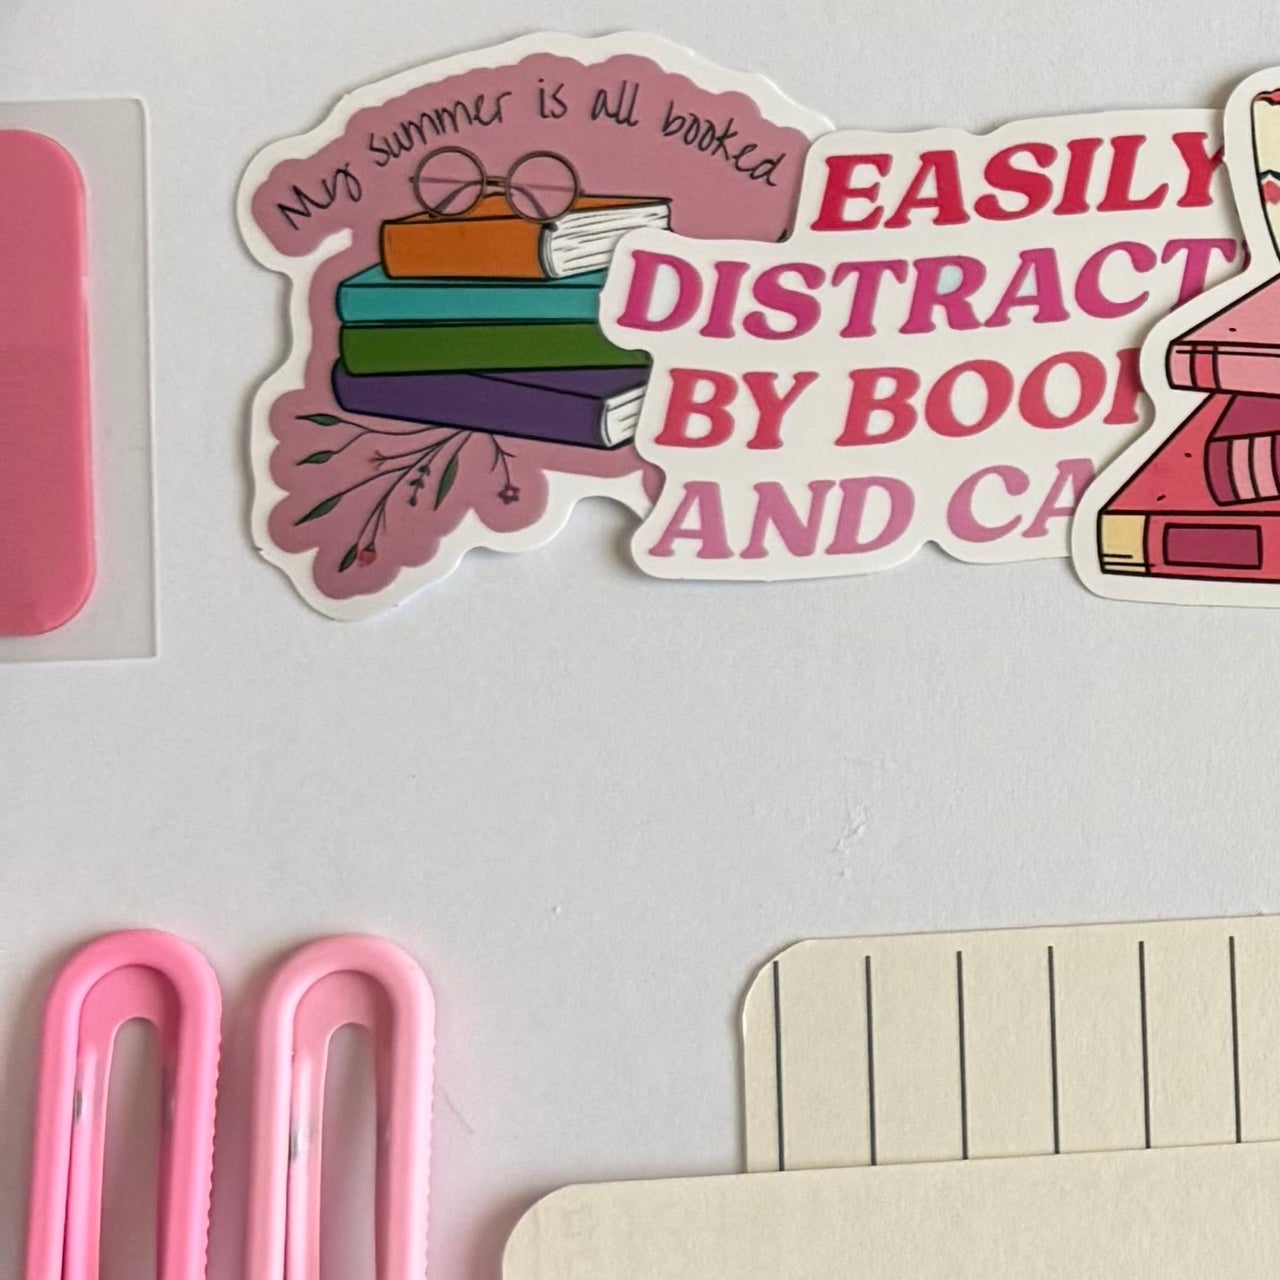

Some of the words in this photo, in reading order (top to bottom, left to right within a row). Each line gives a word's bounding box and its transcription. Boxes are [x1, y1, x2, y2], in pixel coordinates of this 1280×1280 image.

[277, 161, 362, 230] My
[369, 91, 512, 168] summer
[537, 78, 568, 119] is
[590, 80, 640, 127] all
[661, 100, 786, 187] booked
[810, 131, 1225, 232] EASILY
[616, 237, 1250, 340] DISTRACT
[653, 367, 820, 450] BY
[648, 475, 916, 559] AND
